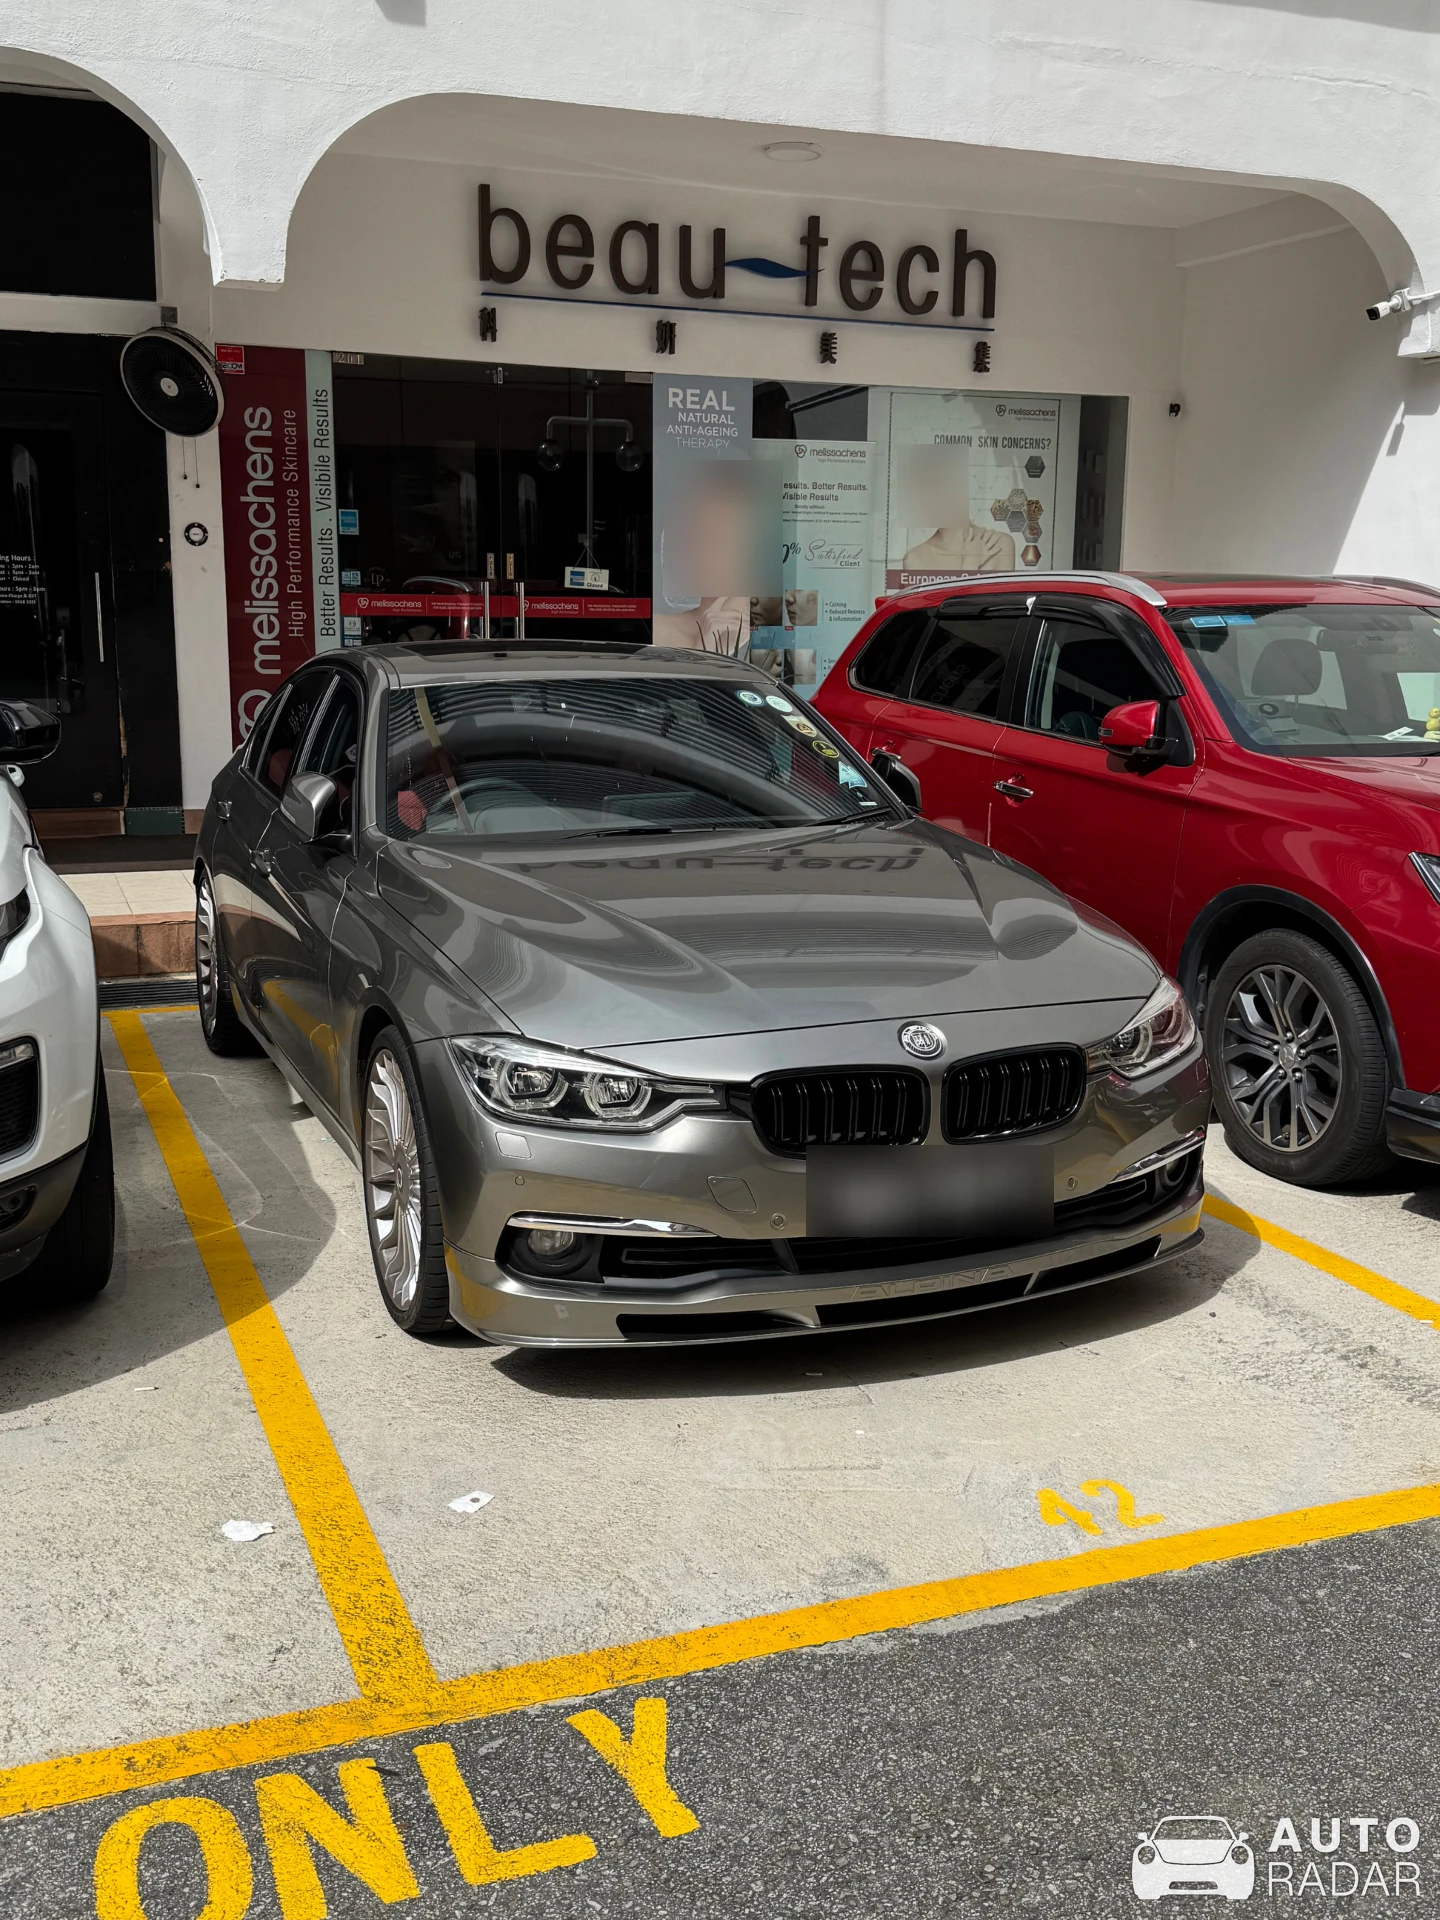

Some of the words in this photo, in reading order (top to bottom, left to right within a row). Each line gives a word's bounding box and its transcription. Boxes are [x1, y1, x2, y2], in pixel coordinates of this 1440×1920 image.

[477, 183, 725, 299] beau
[800, 215, 997, 319] tech
[337, 353, 363, 364] 201
[668, 388, 735, 411] REAL
[312, 388, 330, 448] Results
[667, 425, 738, 437] ANTI-AGEING
[678, 412, 734, 424] NATURAL
[282, 410, 298, 481] Skincare
[675, 437, 730, 449] THERAPY
[810, 447, 866, 458] melissachens
[934, 434, 972, 447] COMMON
[978, 436, 998, 448] SKIN
[1001, 437, 1052, 450] CONCERNS?
[314, 455, 332, 512] Visibile
[783, 482, 809, 490] esults.
[812, 482, 835, 490] Better
[838, 482, 868, 491] Results.
[810, 492, 839, 501] Results
[240, 407, 281, 674] melissachens
[286, 489, 302, 593] Performance
[317, 528, 334, 585] Results
[288, 601, 306, 637] High
[320, 591, 336, 636] Better
[371, 599, 422, 608] melissachens
[850, 1263, 1013, 1300] ALPINA
[1037, 1478, 1166, 1536] 42
[94, 1697, 700, 1920] ONLY
